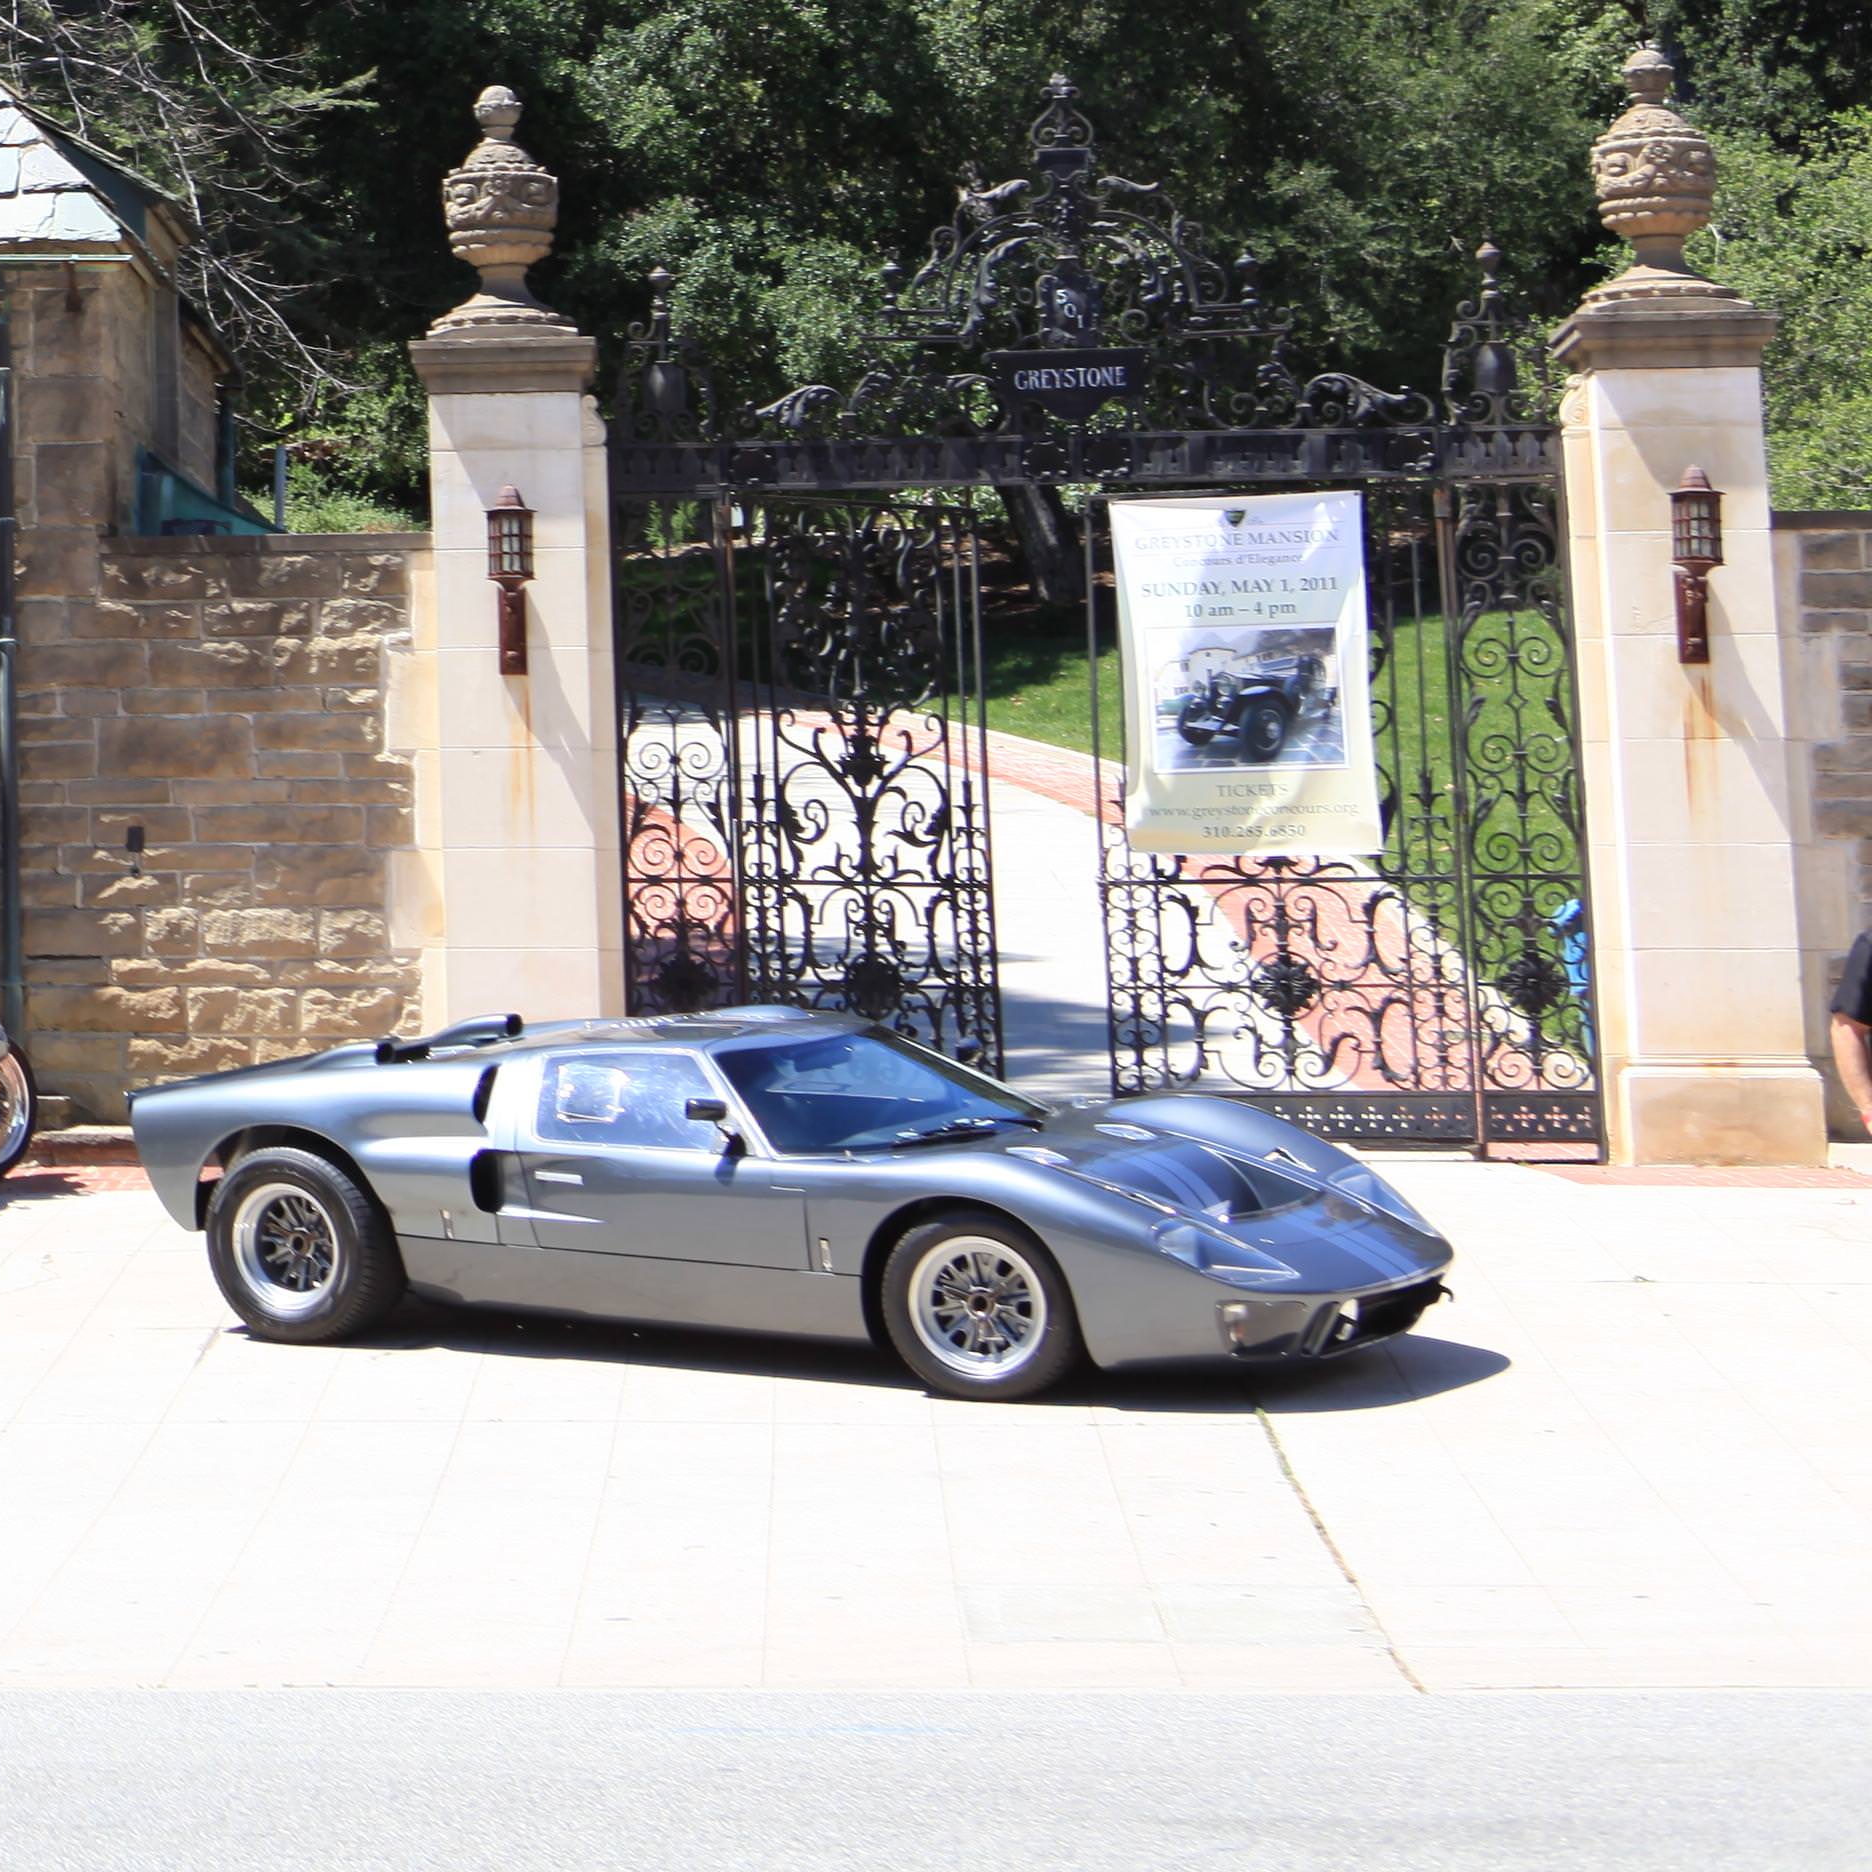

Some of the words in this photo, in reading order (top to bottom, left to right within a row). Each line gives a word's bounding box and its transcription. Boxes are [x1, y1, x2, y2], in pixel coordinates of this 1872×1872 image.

[1056, 289, 1084, 329] 501
[1014, 366, 1127, 390] GREYSTONE
[1136, 532, 1243, 550] GREYSTONE
[1248, 529, 1340, 546] MANSION
[1141, 580, 1226, 598] SUNDAY,
[1231, 579, 1275, 594] MAY
[1281, 578, 1295, 594] 1,
[1300, 576, 1337, 591] 2011
[1185, 604, 1202, 618] 10
[1208, 606, 1234, 617] am
[1253, 602, 1262, 615] 4
[1268, 603, 1297, 619] pm
[1216, 784, 1289, 797] TICKETS
